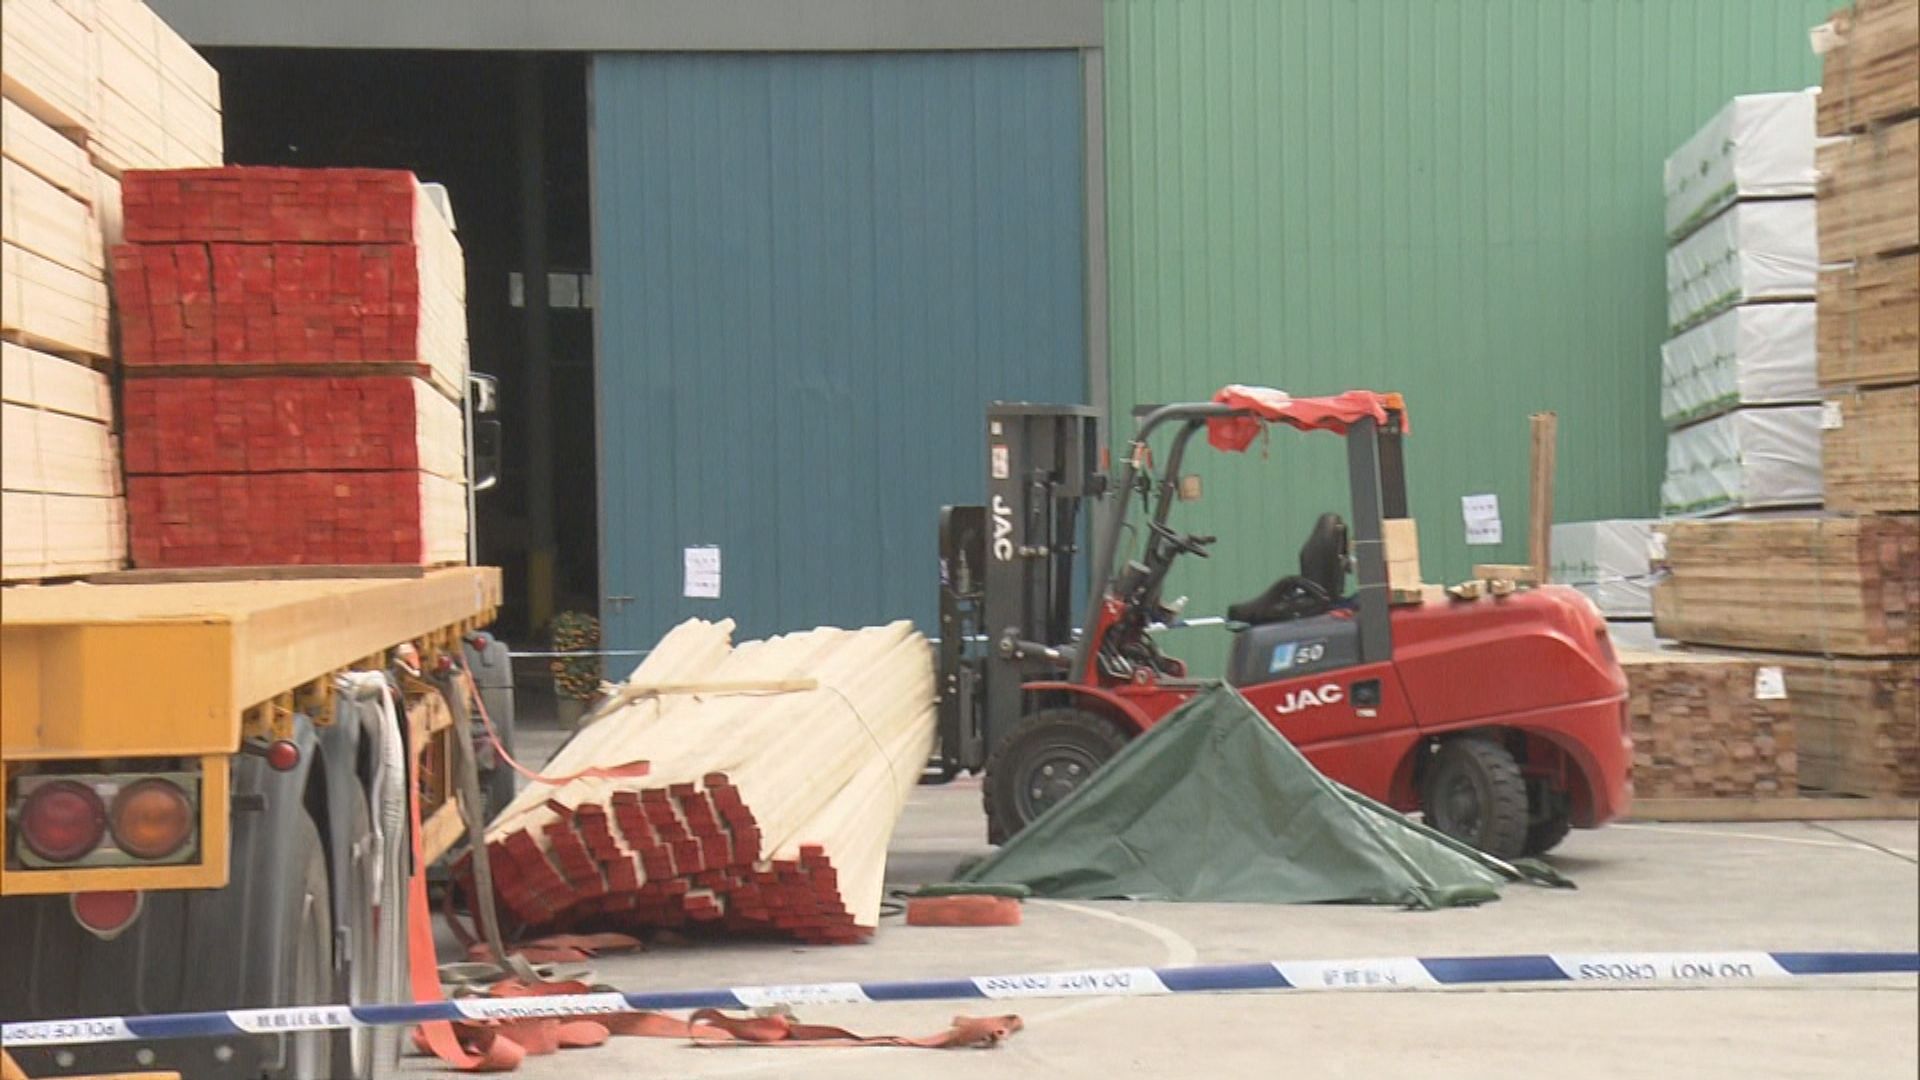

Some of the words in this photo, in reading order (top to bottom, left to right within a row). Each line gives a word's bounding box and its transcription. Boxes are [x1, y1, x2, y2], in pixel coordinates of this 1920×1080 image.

[992, 494, 1012, 561] JAC
[1295, 643, 1324, 664] 50
[1275, 683, 1343, 714] JAC
[1579, 963, 1657, 980] CROSS
[1671, 961, 1714, 979] NOT
[1719, 963, 1754, 978] DO
